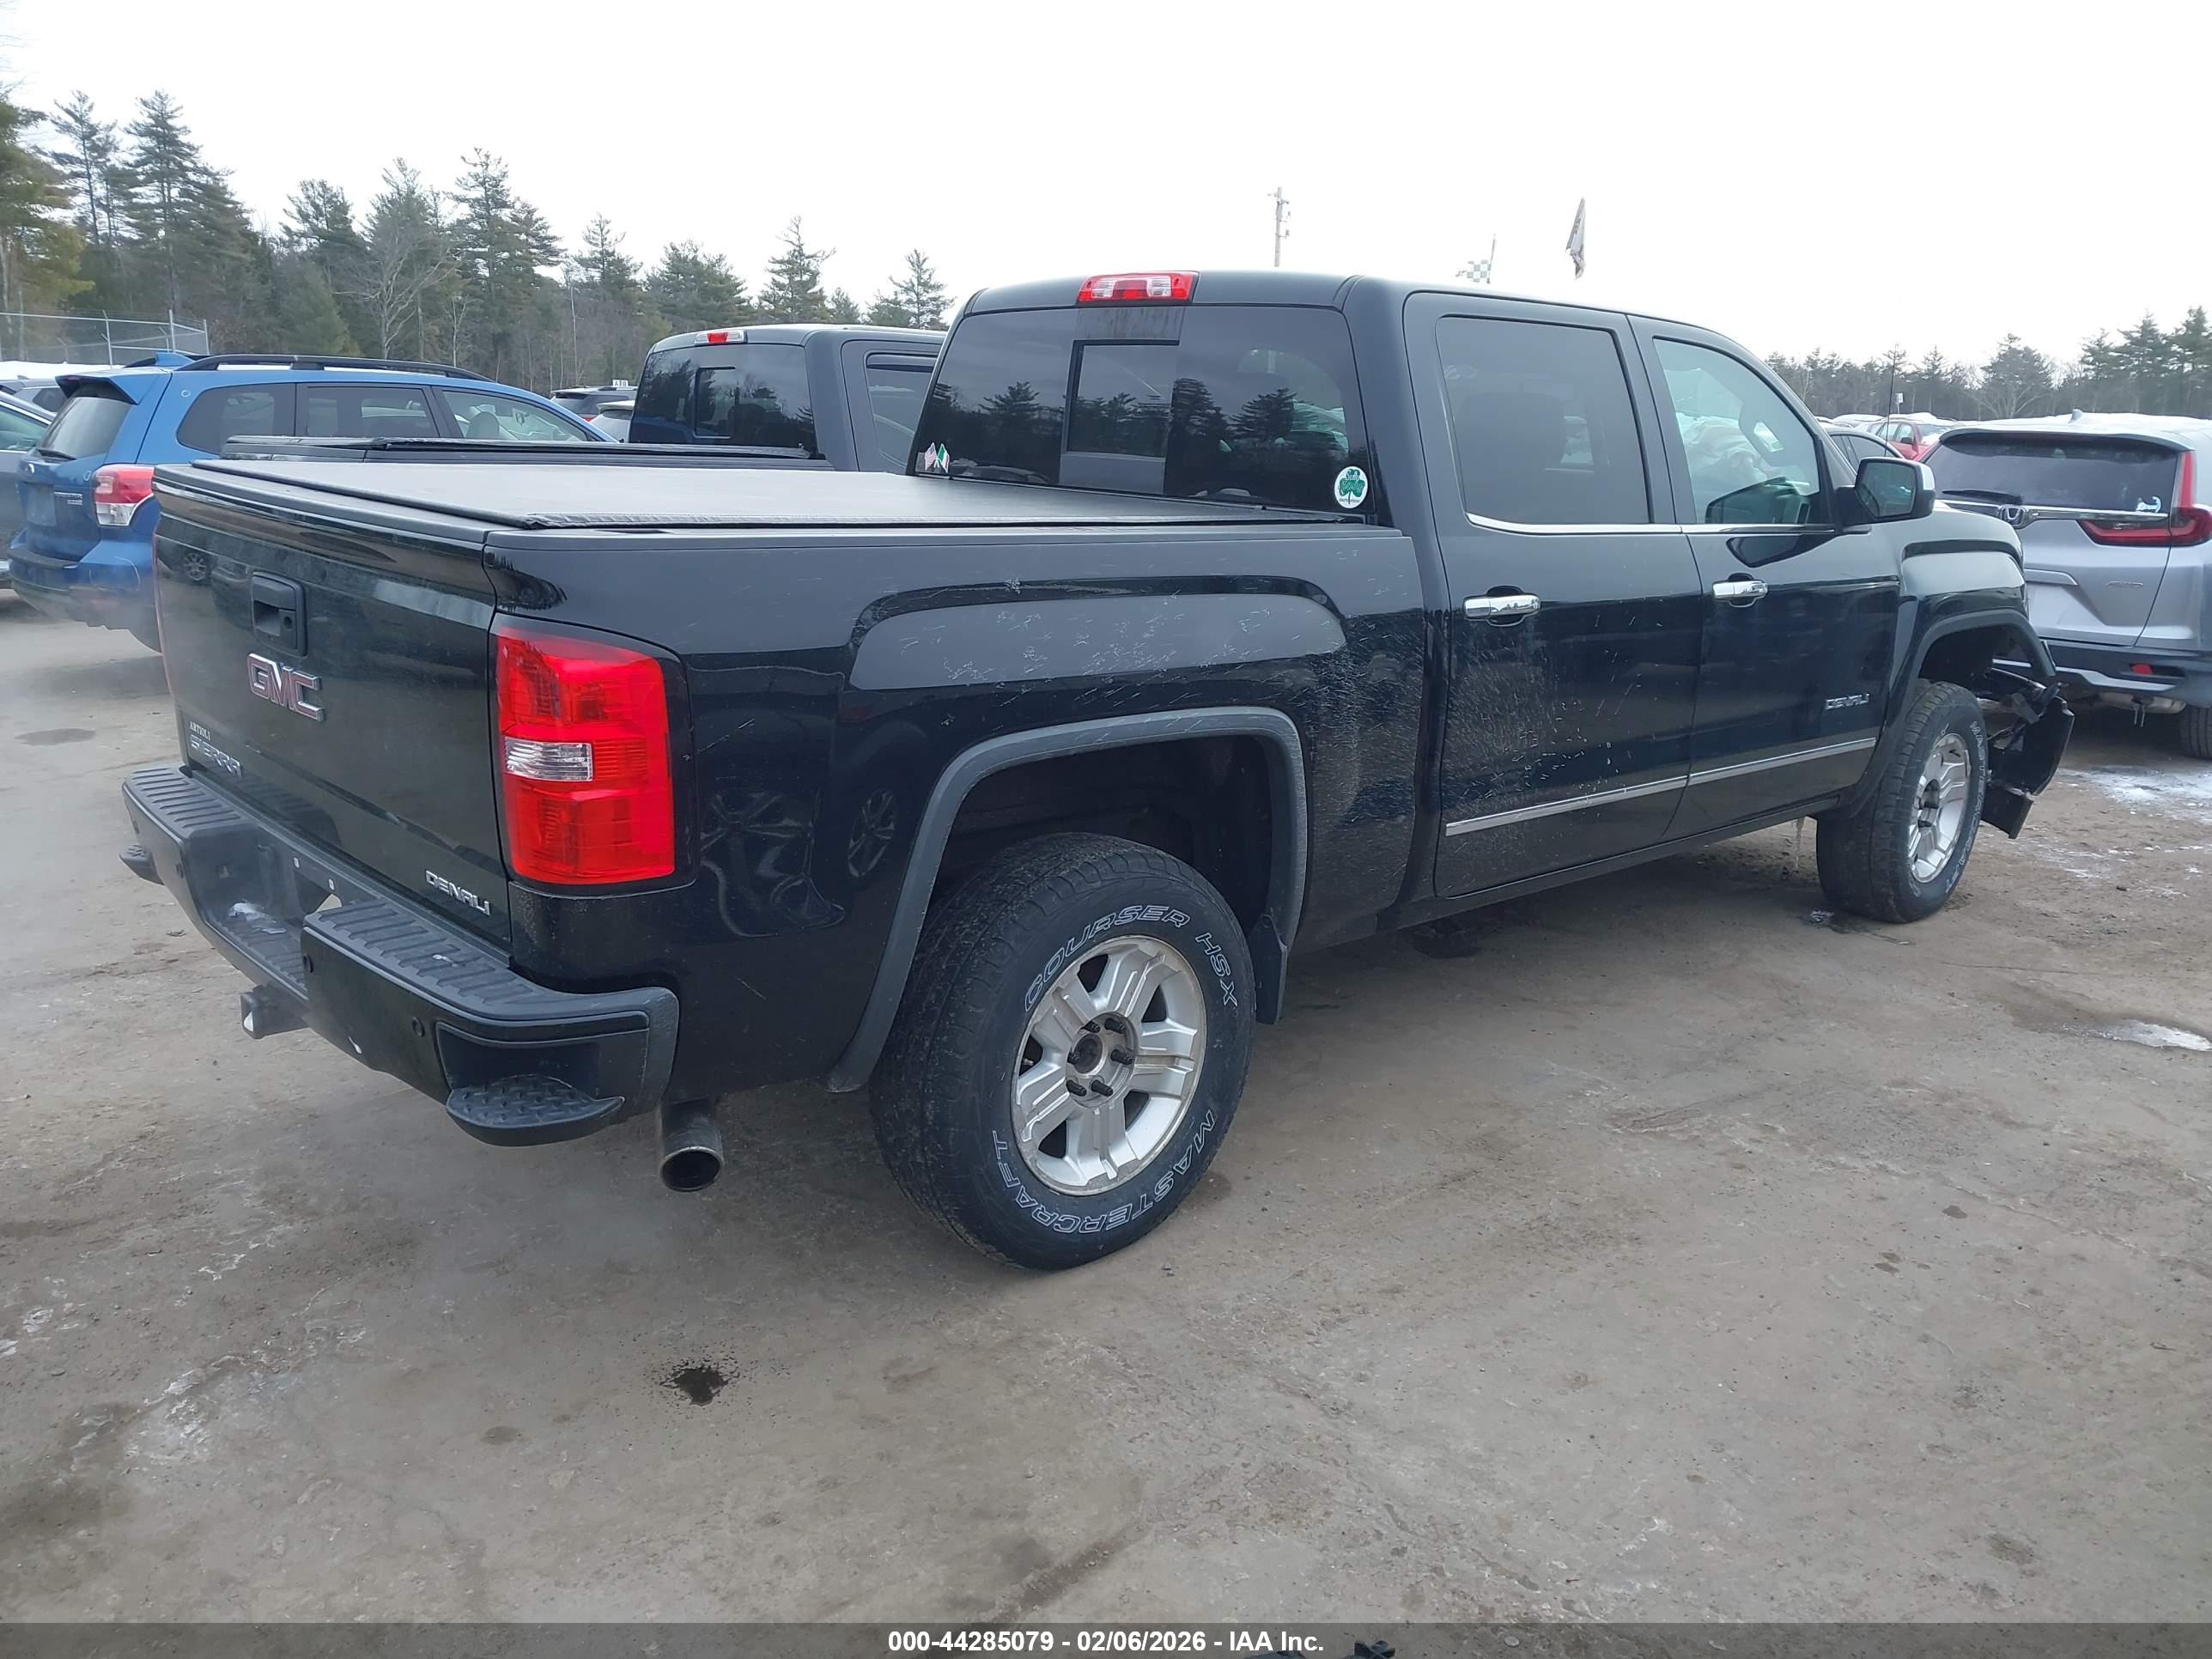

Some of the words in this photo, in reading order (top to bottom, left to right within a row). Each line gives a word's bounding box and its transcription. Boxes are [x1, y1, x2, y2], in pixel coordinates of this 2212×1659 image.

[247, 653, 324, 722] GMC
[425, 870, 490, 916] DENALI
[1024, 905, 1190, 1012] COURSER
[1194, 933, 1238, 1007] HSX
[993, 1109, 1216, 1234] MASTERCRAFT
